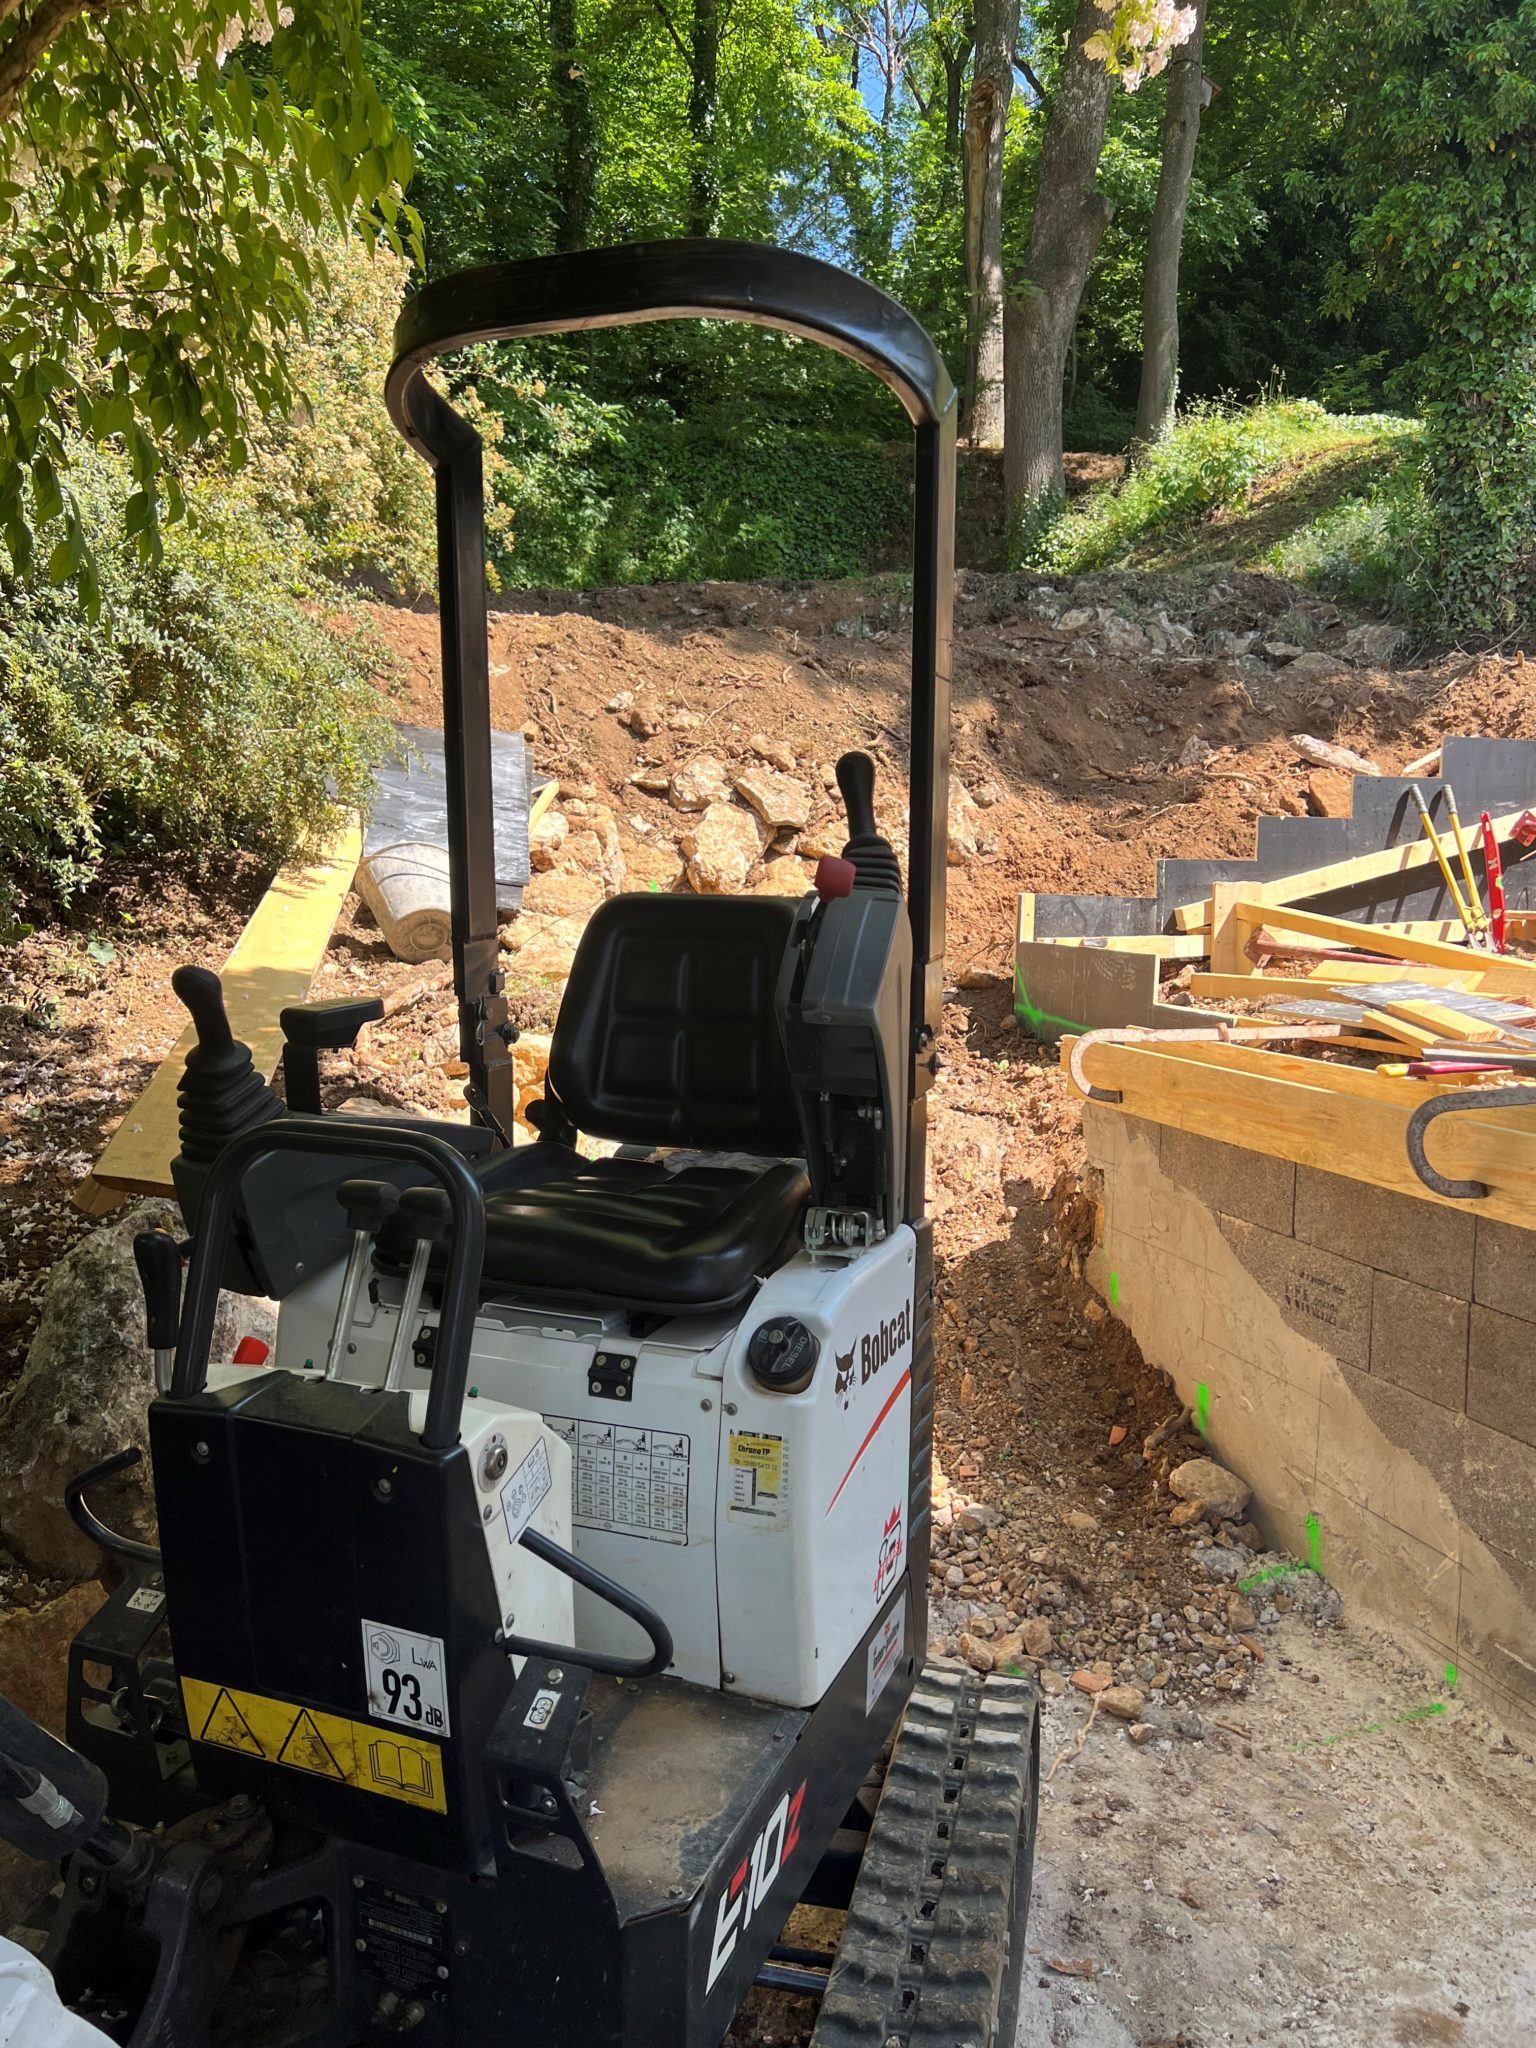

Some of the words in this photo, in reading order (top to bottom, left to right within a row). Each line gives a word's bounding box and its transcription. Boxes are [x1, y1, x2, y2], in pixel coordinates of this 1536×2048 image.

[782, 1336, 808, 1369] DIESEL
[861, 1298, 911, 1386] Bobcat
[738, 1444, 761, 1455] Chrono
[762, 1448, 771, 1456] TP
[382, 1668, 422, 1722] 93
[426, 1704, 444, 1728] dB
